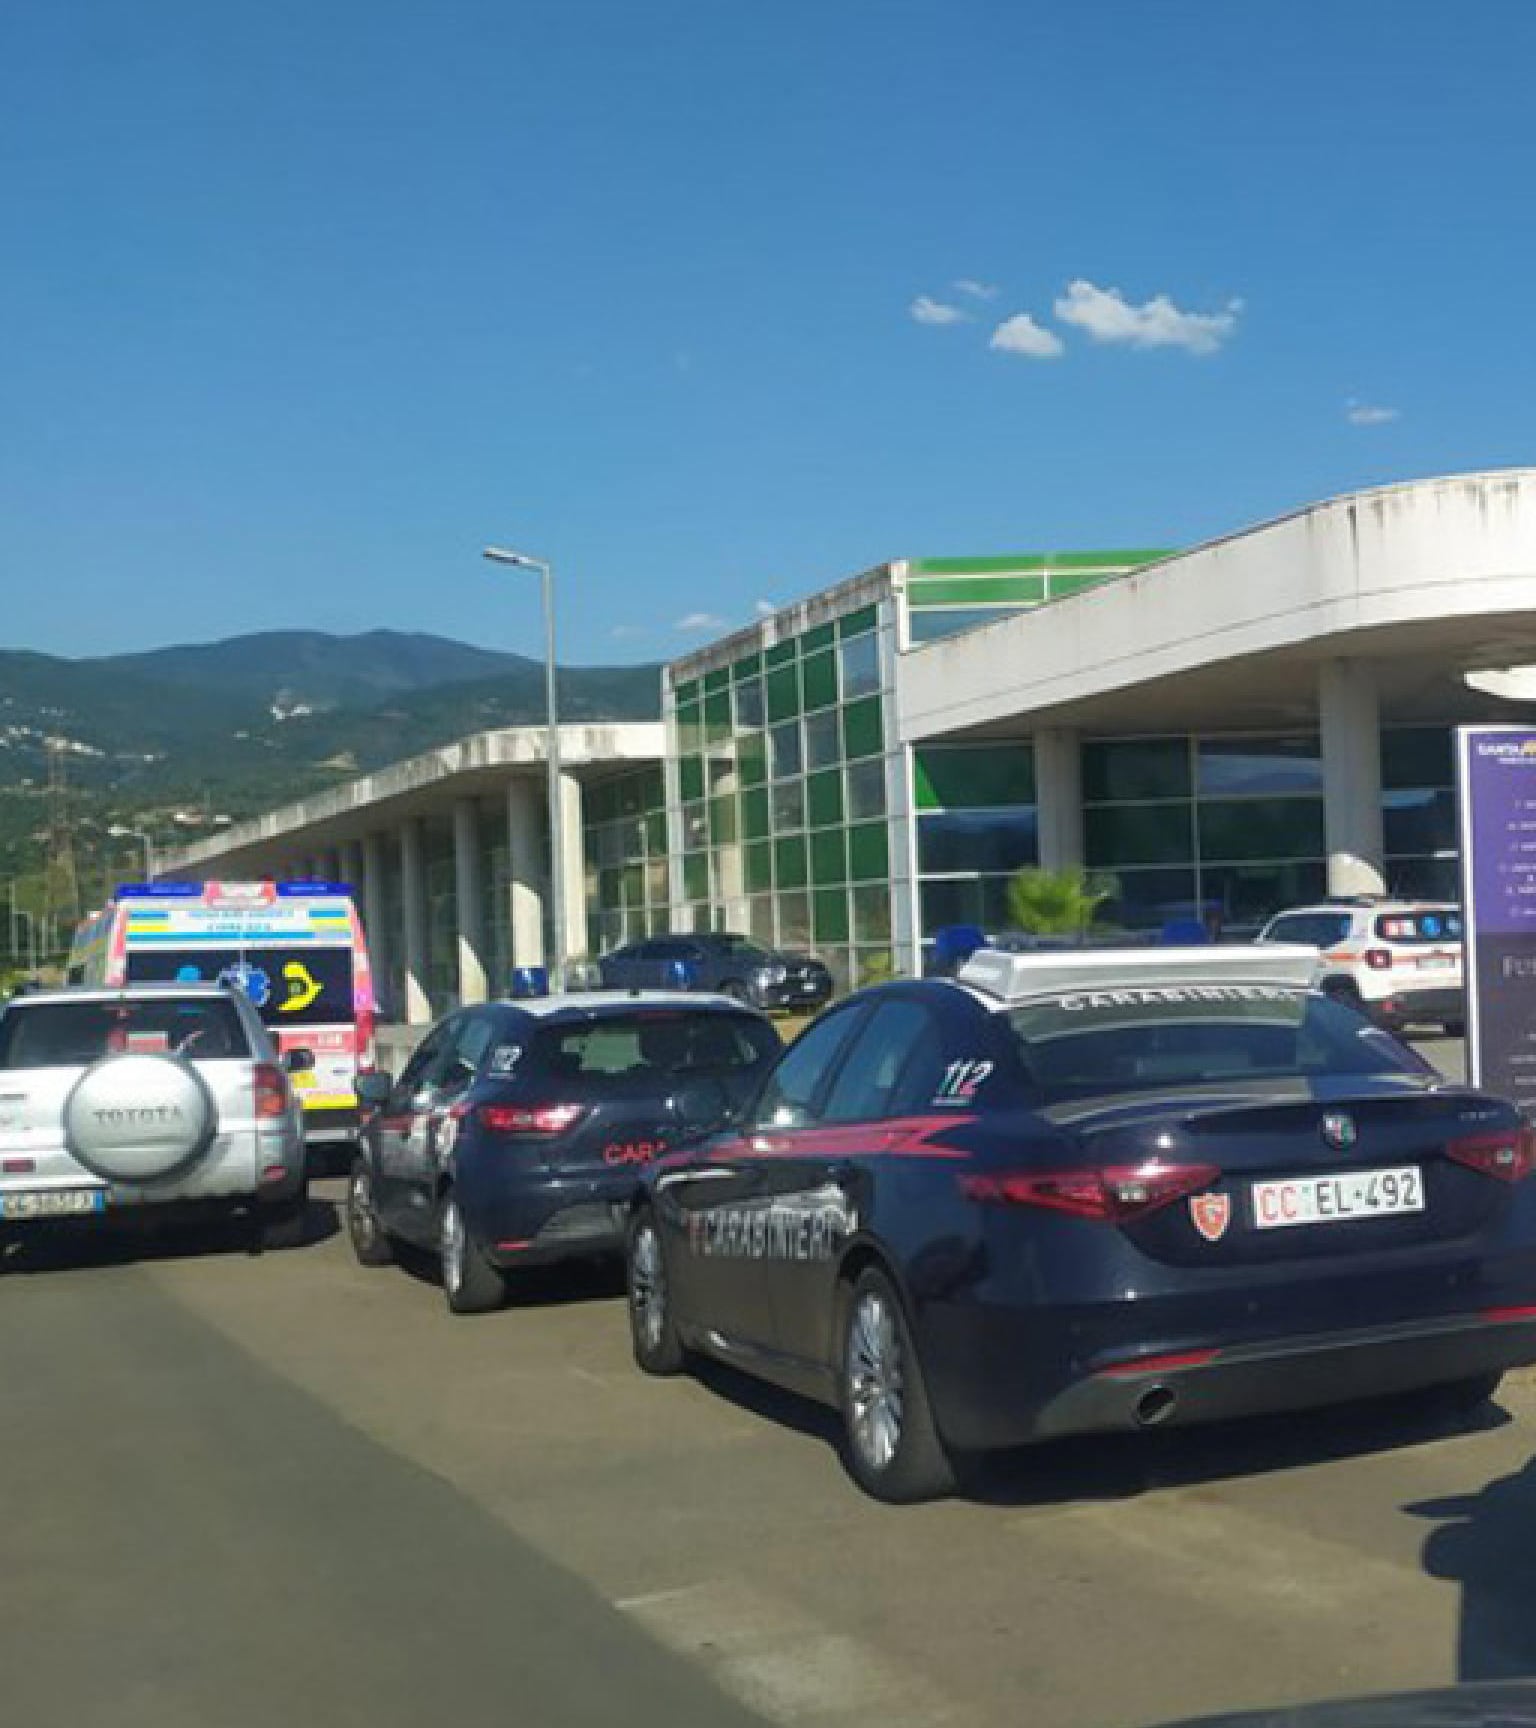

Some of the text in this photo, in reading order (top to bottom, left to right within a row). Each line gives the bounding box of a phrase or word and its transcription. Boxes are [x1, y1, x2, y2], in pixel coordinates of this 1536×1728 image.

[938, 1057, 994, 1096] 112
[93, 1105, 184, 1126] TOYOTA
[1261, 1185, 1297, 1221] CC
